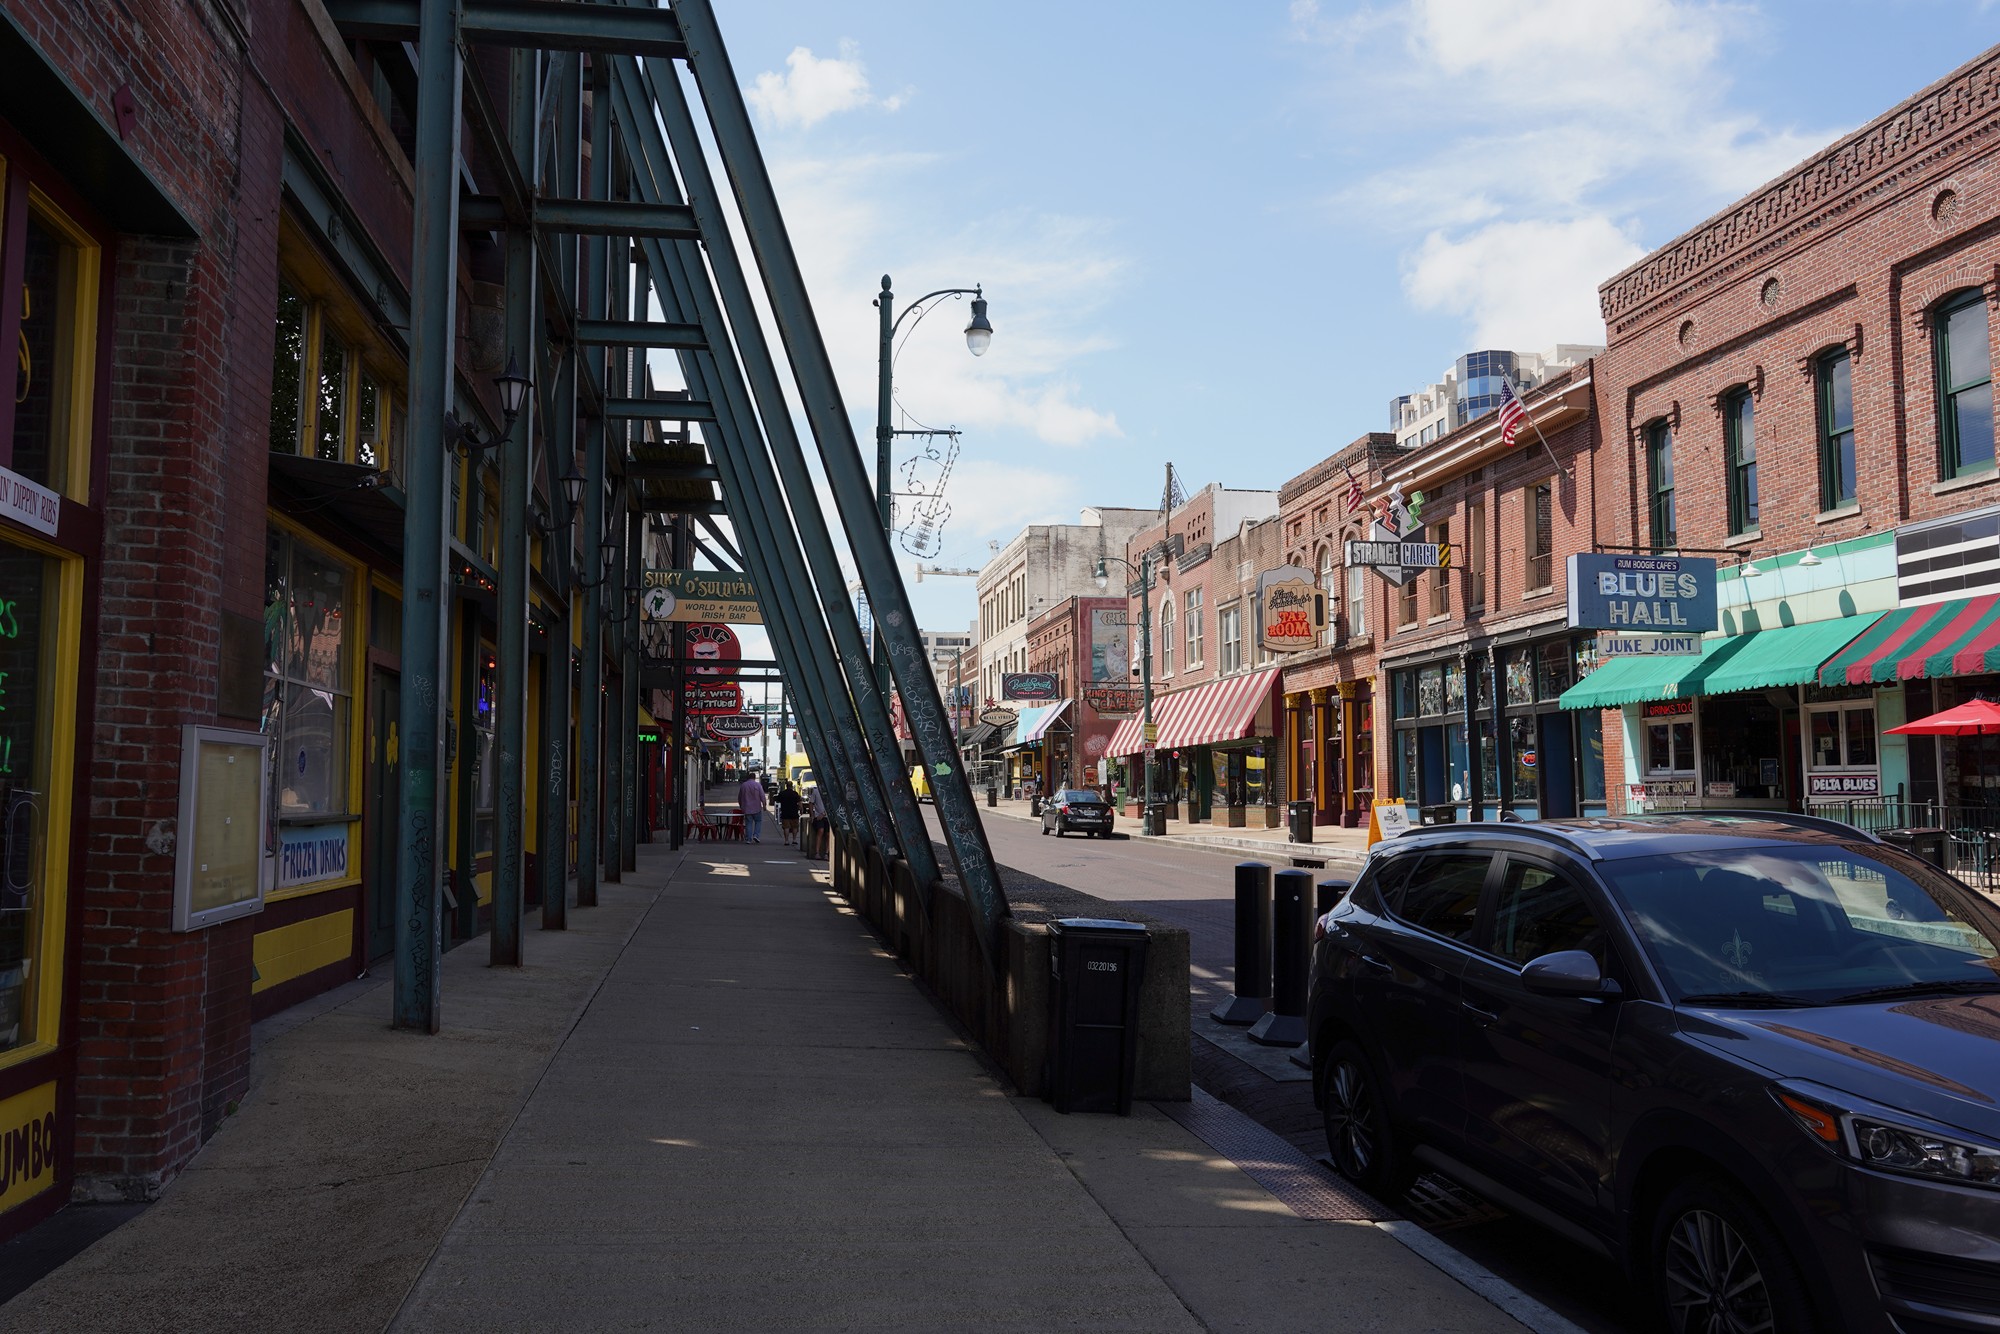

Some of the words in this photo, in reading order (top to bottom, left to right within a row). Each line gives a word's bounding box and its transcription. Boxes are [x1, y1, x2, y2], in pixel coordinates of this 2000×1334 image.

[13, 482, 40, 516] DIPPIN'
[41, 495, 57, 525] RIBS
[1353, 542, 1399, 565] STRANGE
[1403, 544, 1437, 566] CARGO
[1617, 559, 1632, 569] RUM
[1633, 560, 1655, 569] BOOGIE
[644, 571, 682, 588] SILKY
[1598, 571, 1698, 599] BLUES
[685, 603, 716, 612] WORLD
[1609, 600, 1688, 626] HALL
[1279, 611, 1307, 624] TAP
[687, 625, 731, 644] PIG
[1268, 621, 1312, 637] ROOM
[1605, 639, 1642, 653] JUKE
[1651, 637, 1693, 652] JOINT
[709, 690, 736, 698] WITH
[1115, 690, 1145, 699] PALAC
[1649, 704, 1675, 716] DRINKS
[1676, 702, 1687, 713] TO
[638, 734, 658, 742] TM
[1812, 778, 1840, 792] DELTA
[1843, 778, 1877, 792] BLUES
[283, 839, 317, 881] FROZEN
[320, 838, 346, 875] DRINKS
[1087, 961, 1118, 972] 03220196
[0, 1111, 55, 1197] UMBO
